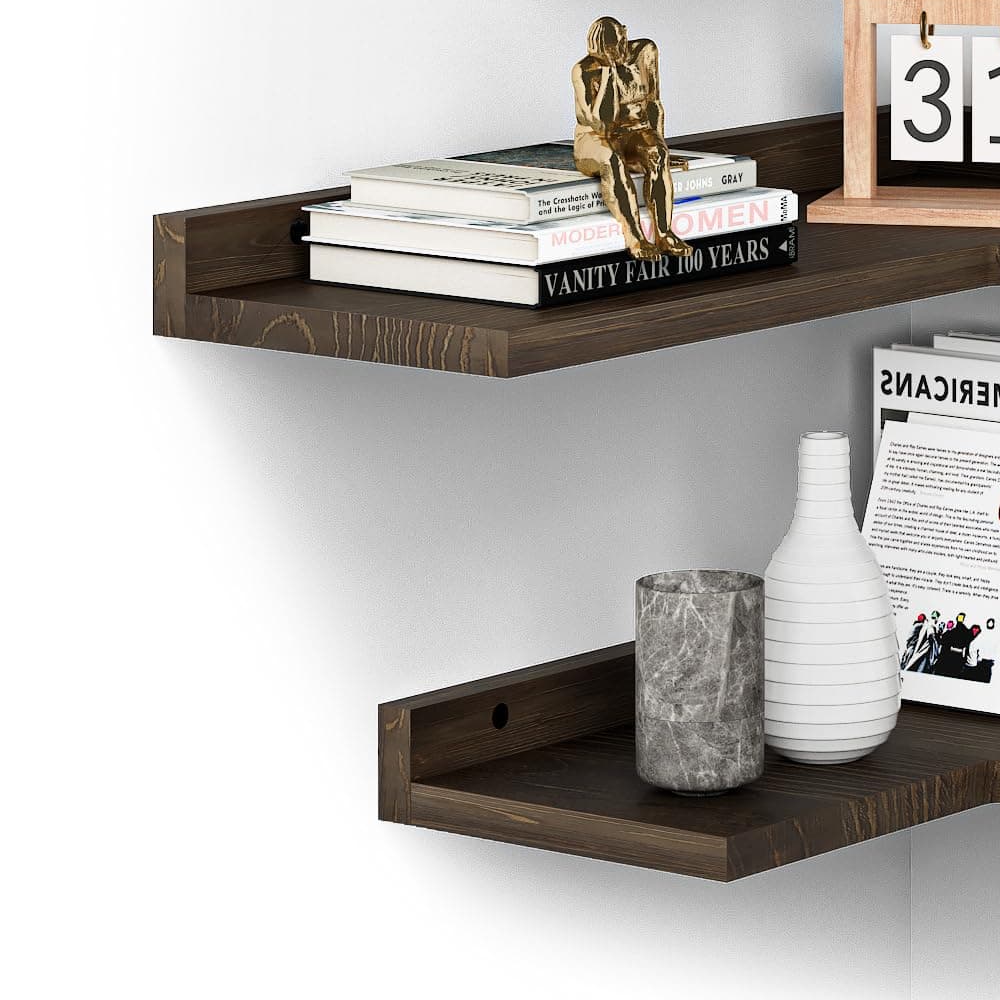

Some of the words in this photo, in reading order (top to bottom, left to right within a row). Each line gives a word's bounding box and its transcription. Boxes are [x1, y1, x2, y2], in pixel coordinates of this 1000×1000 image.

[685, 177, 712, 190] JOHNS
[721, 172, 743, 184] GRAY
[553, 193, 589, 205] Crosshatch
[538, 207, 552, 216] and
[555, 205, 565, 213] the
[568, 203, 585, 212] Logic
[552, 223, 620, 247] MODER
[544, 262, 620, 297] VANITY
[625, 255, 670, 284] FAIR
[677, 248, 703, 275] 100
[708, 237, 769, 269] YEARS
